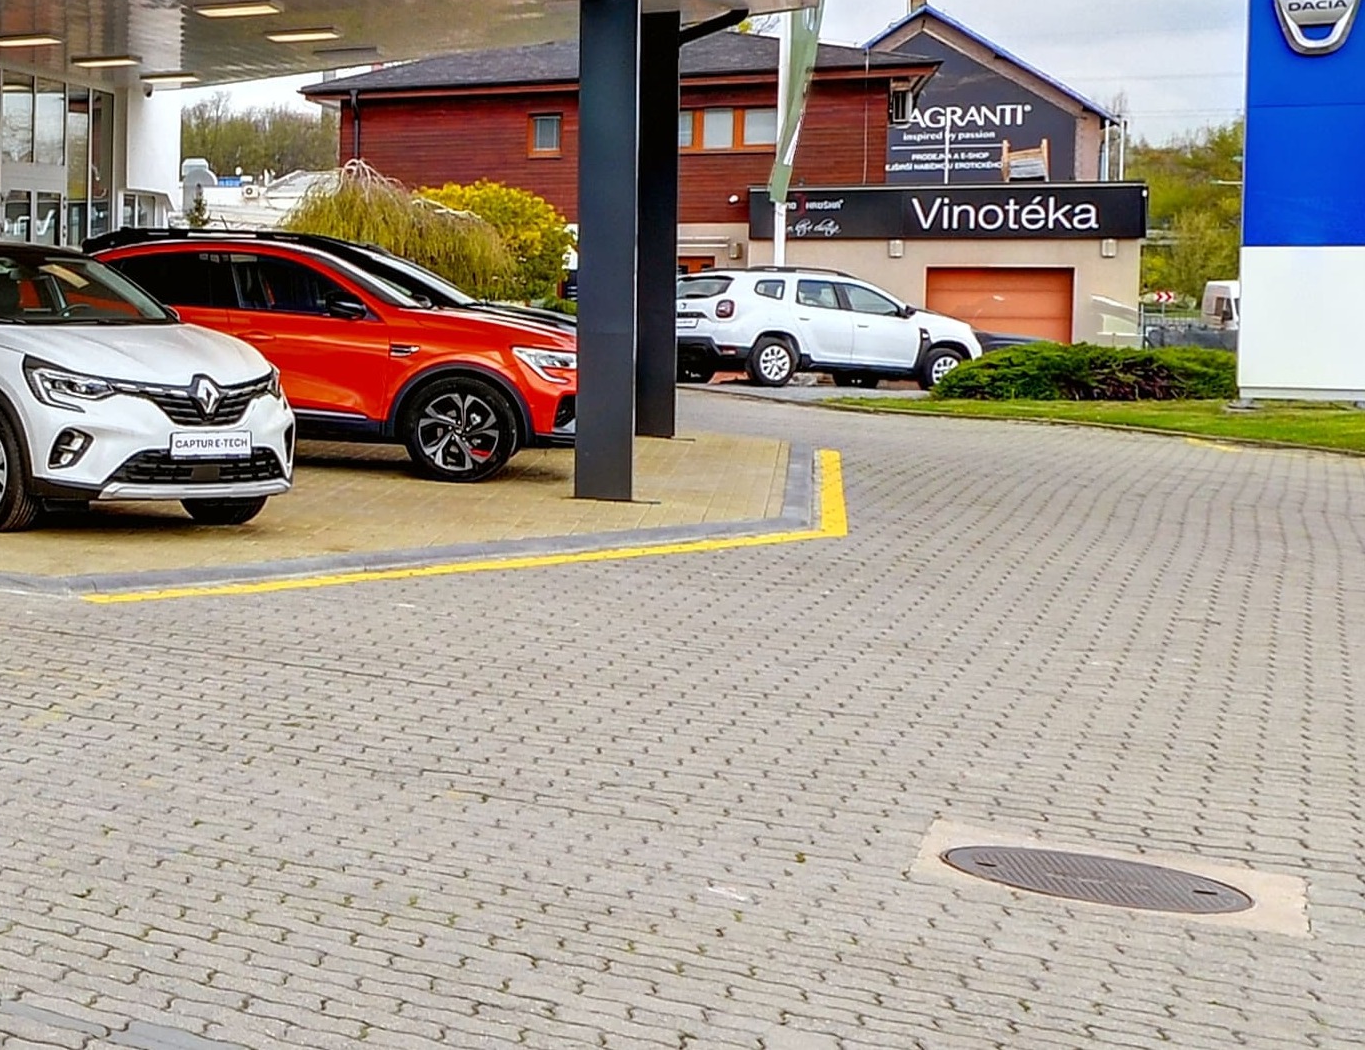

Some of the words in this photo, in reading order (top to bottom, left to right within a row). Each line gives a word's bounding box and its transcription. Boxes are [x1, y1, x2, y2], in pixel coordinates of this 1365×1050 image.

[1288, 0, 1347, 11] DACIA
[909, 104, 1024, 128] AGRANTI
[958, 130, 996, 140] passion
[911, 196, 1100, 230] Vinotéka
[175, 439, 214, 449] CAPTUR
[215, 438, 248, 447] E-TECH
